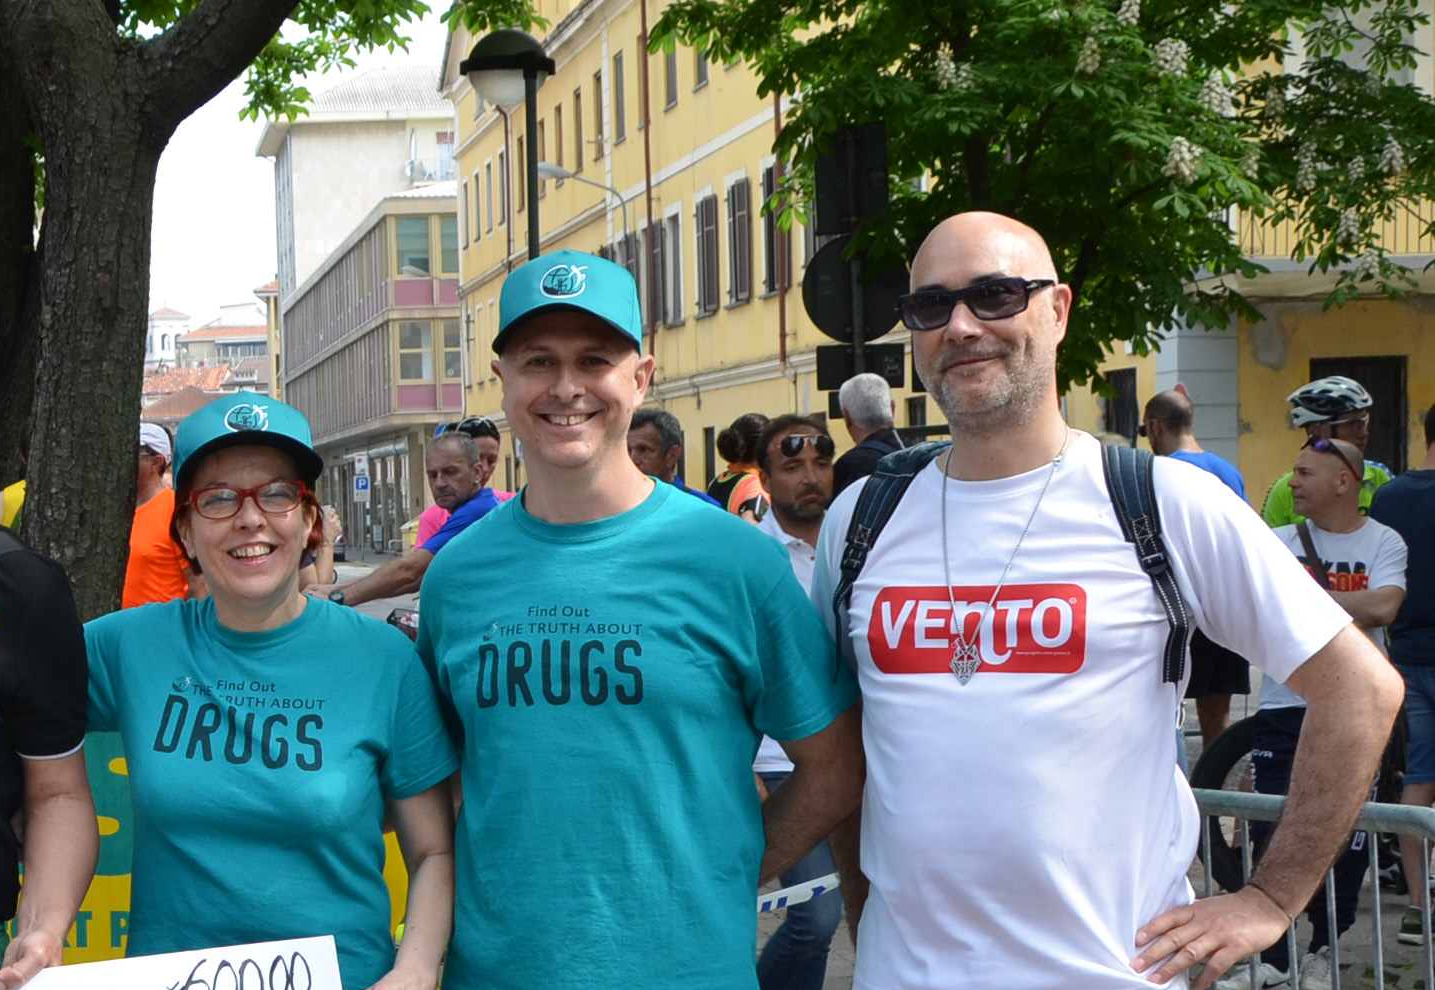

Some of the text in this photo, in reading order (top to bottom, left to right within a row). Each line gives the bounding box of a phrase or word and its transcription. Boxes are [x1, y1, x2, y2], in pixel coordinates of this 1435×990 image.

[527, 605, 591, 618] Find Out
[498, 622, 644, 637] THE TRUTH ABOUT
[475, 638, 644, 709] DRUGS
[216, 679, 276, 693] Find Out
[192, 684, 327, 710] THE RUTH ABOUT
[152, 693, 324, 772] DRUGS
